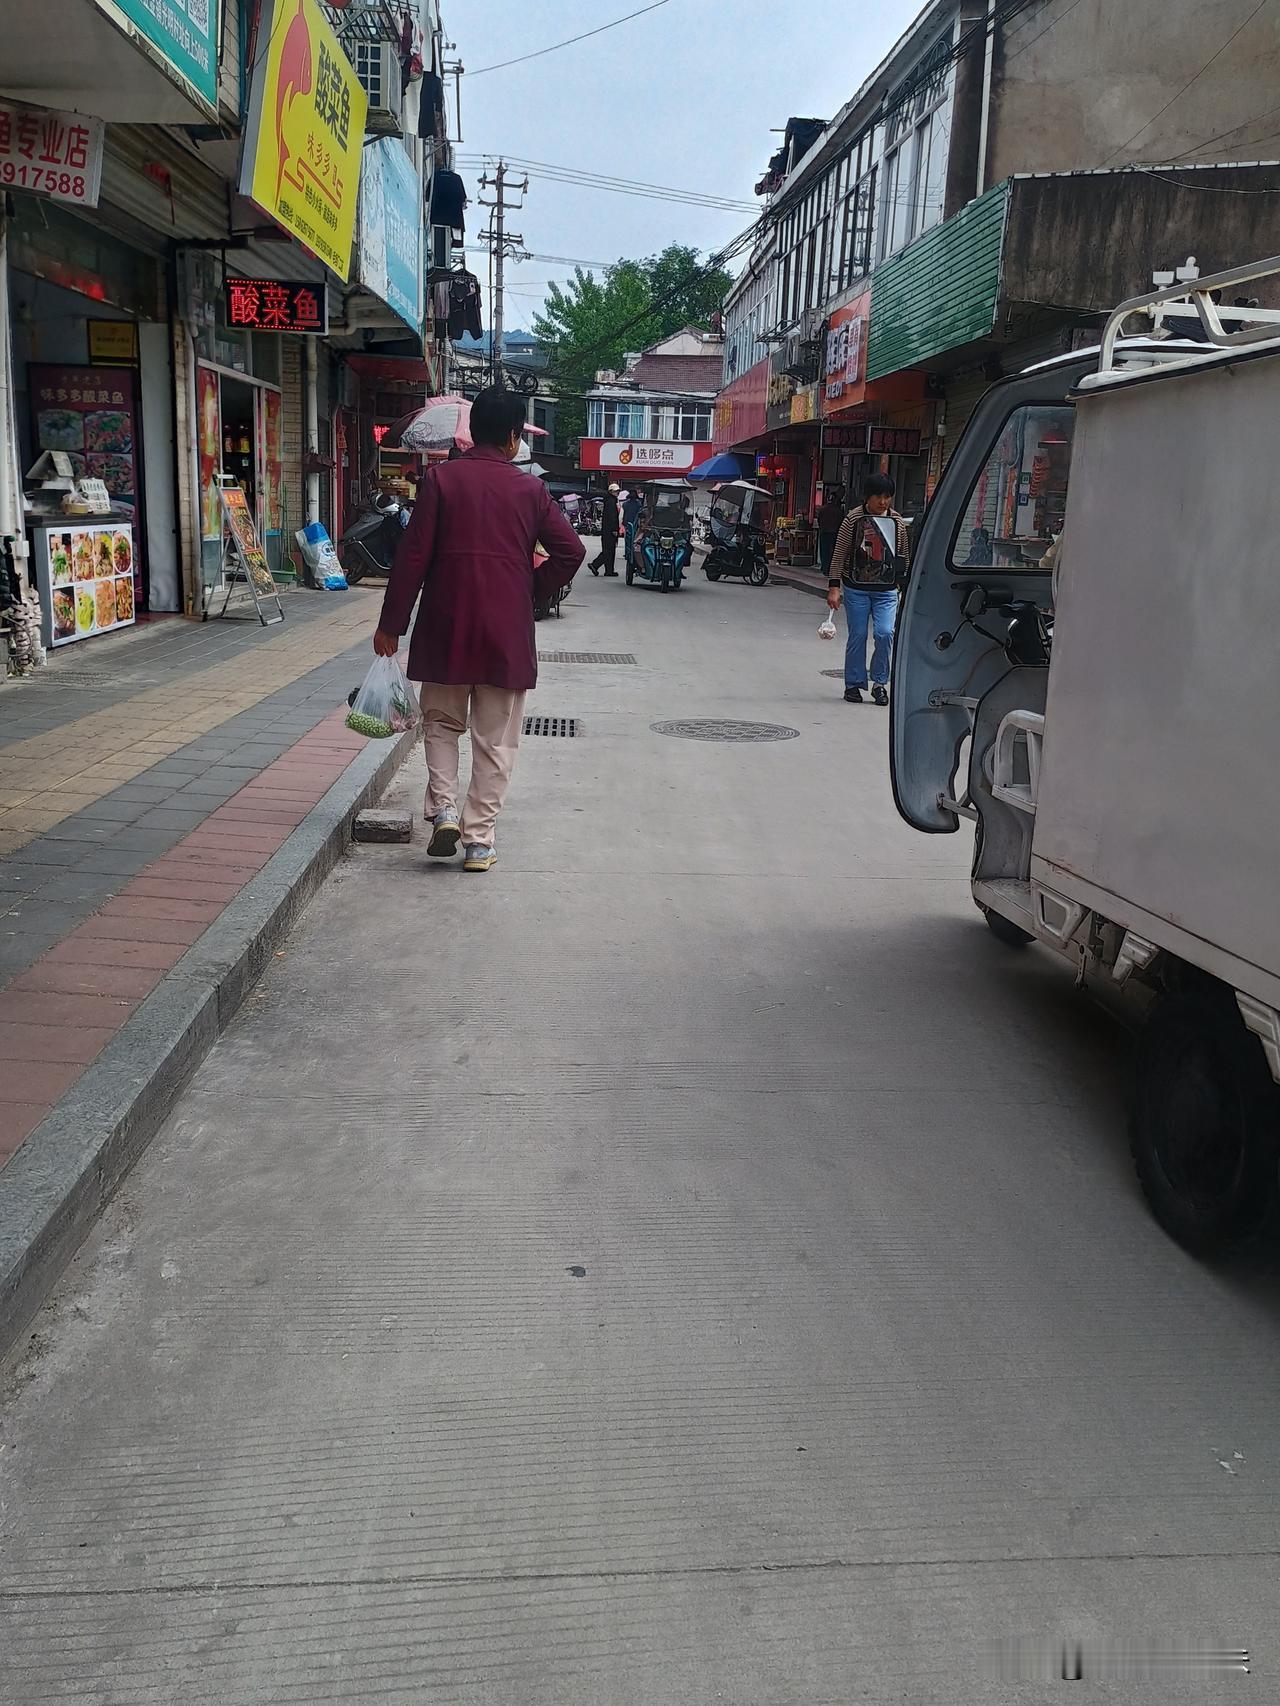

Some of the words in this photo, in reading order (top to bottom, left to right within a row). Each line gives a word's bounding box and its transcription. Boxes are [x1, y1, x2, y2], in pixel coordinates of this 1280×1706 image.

[314, 40, 350, 152] 酸菜鱼
[0, 162, 85, 197] 917588
[230, 285, 321, 326] 酸菜鱼
[636, 448, 674, 461] 选哆点
